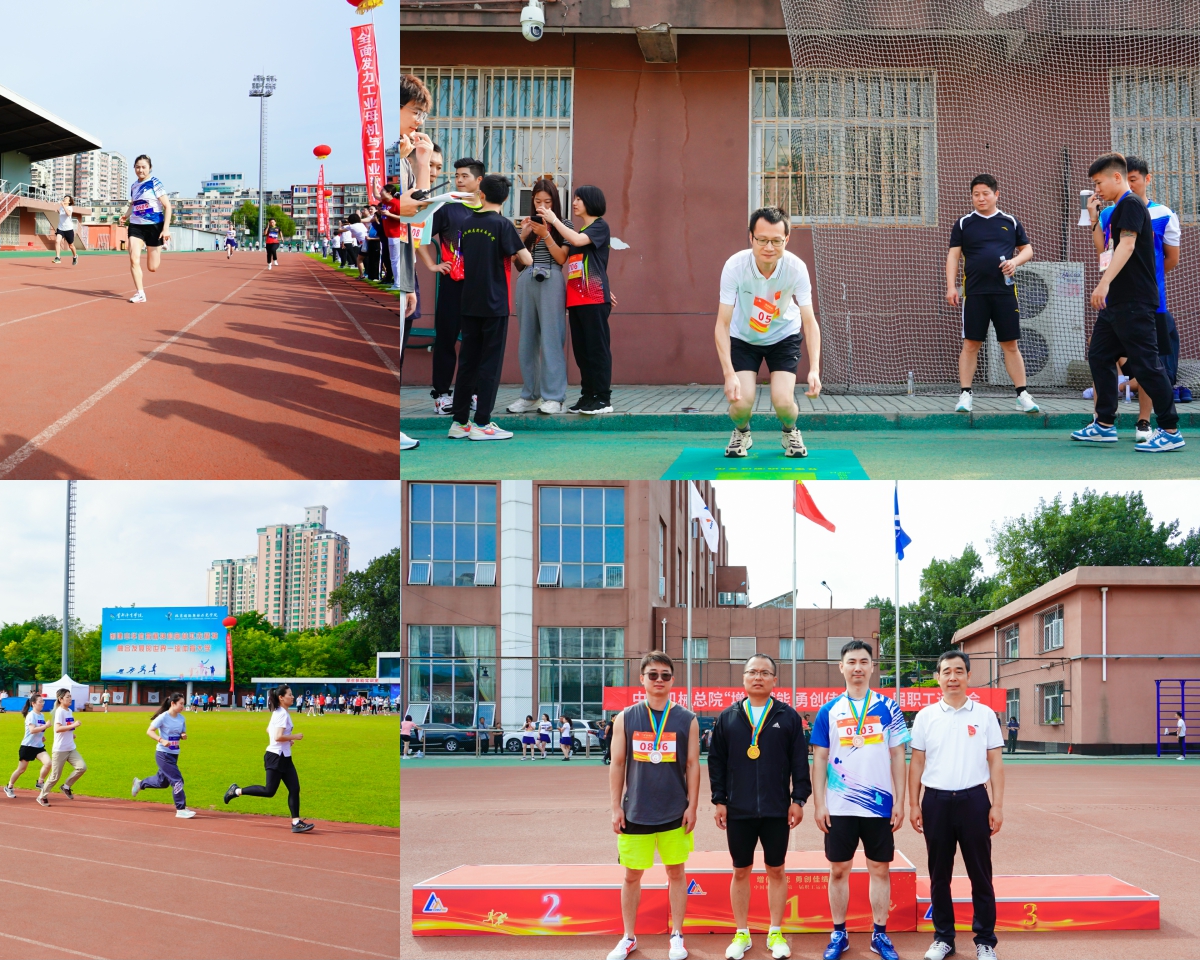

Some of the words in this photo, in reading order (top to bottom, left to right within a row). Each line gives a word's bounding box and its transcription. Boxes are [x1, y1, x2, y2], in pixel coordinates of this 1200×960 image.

[356, 31, 382, 202] 全面发力工业母机与工业软
[542, 893, 561, 923] 2
[785, 895, 804, 923] 1
[1023, 903, 1037, 926] 3
